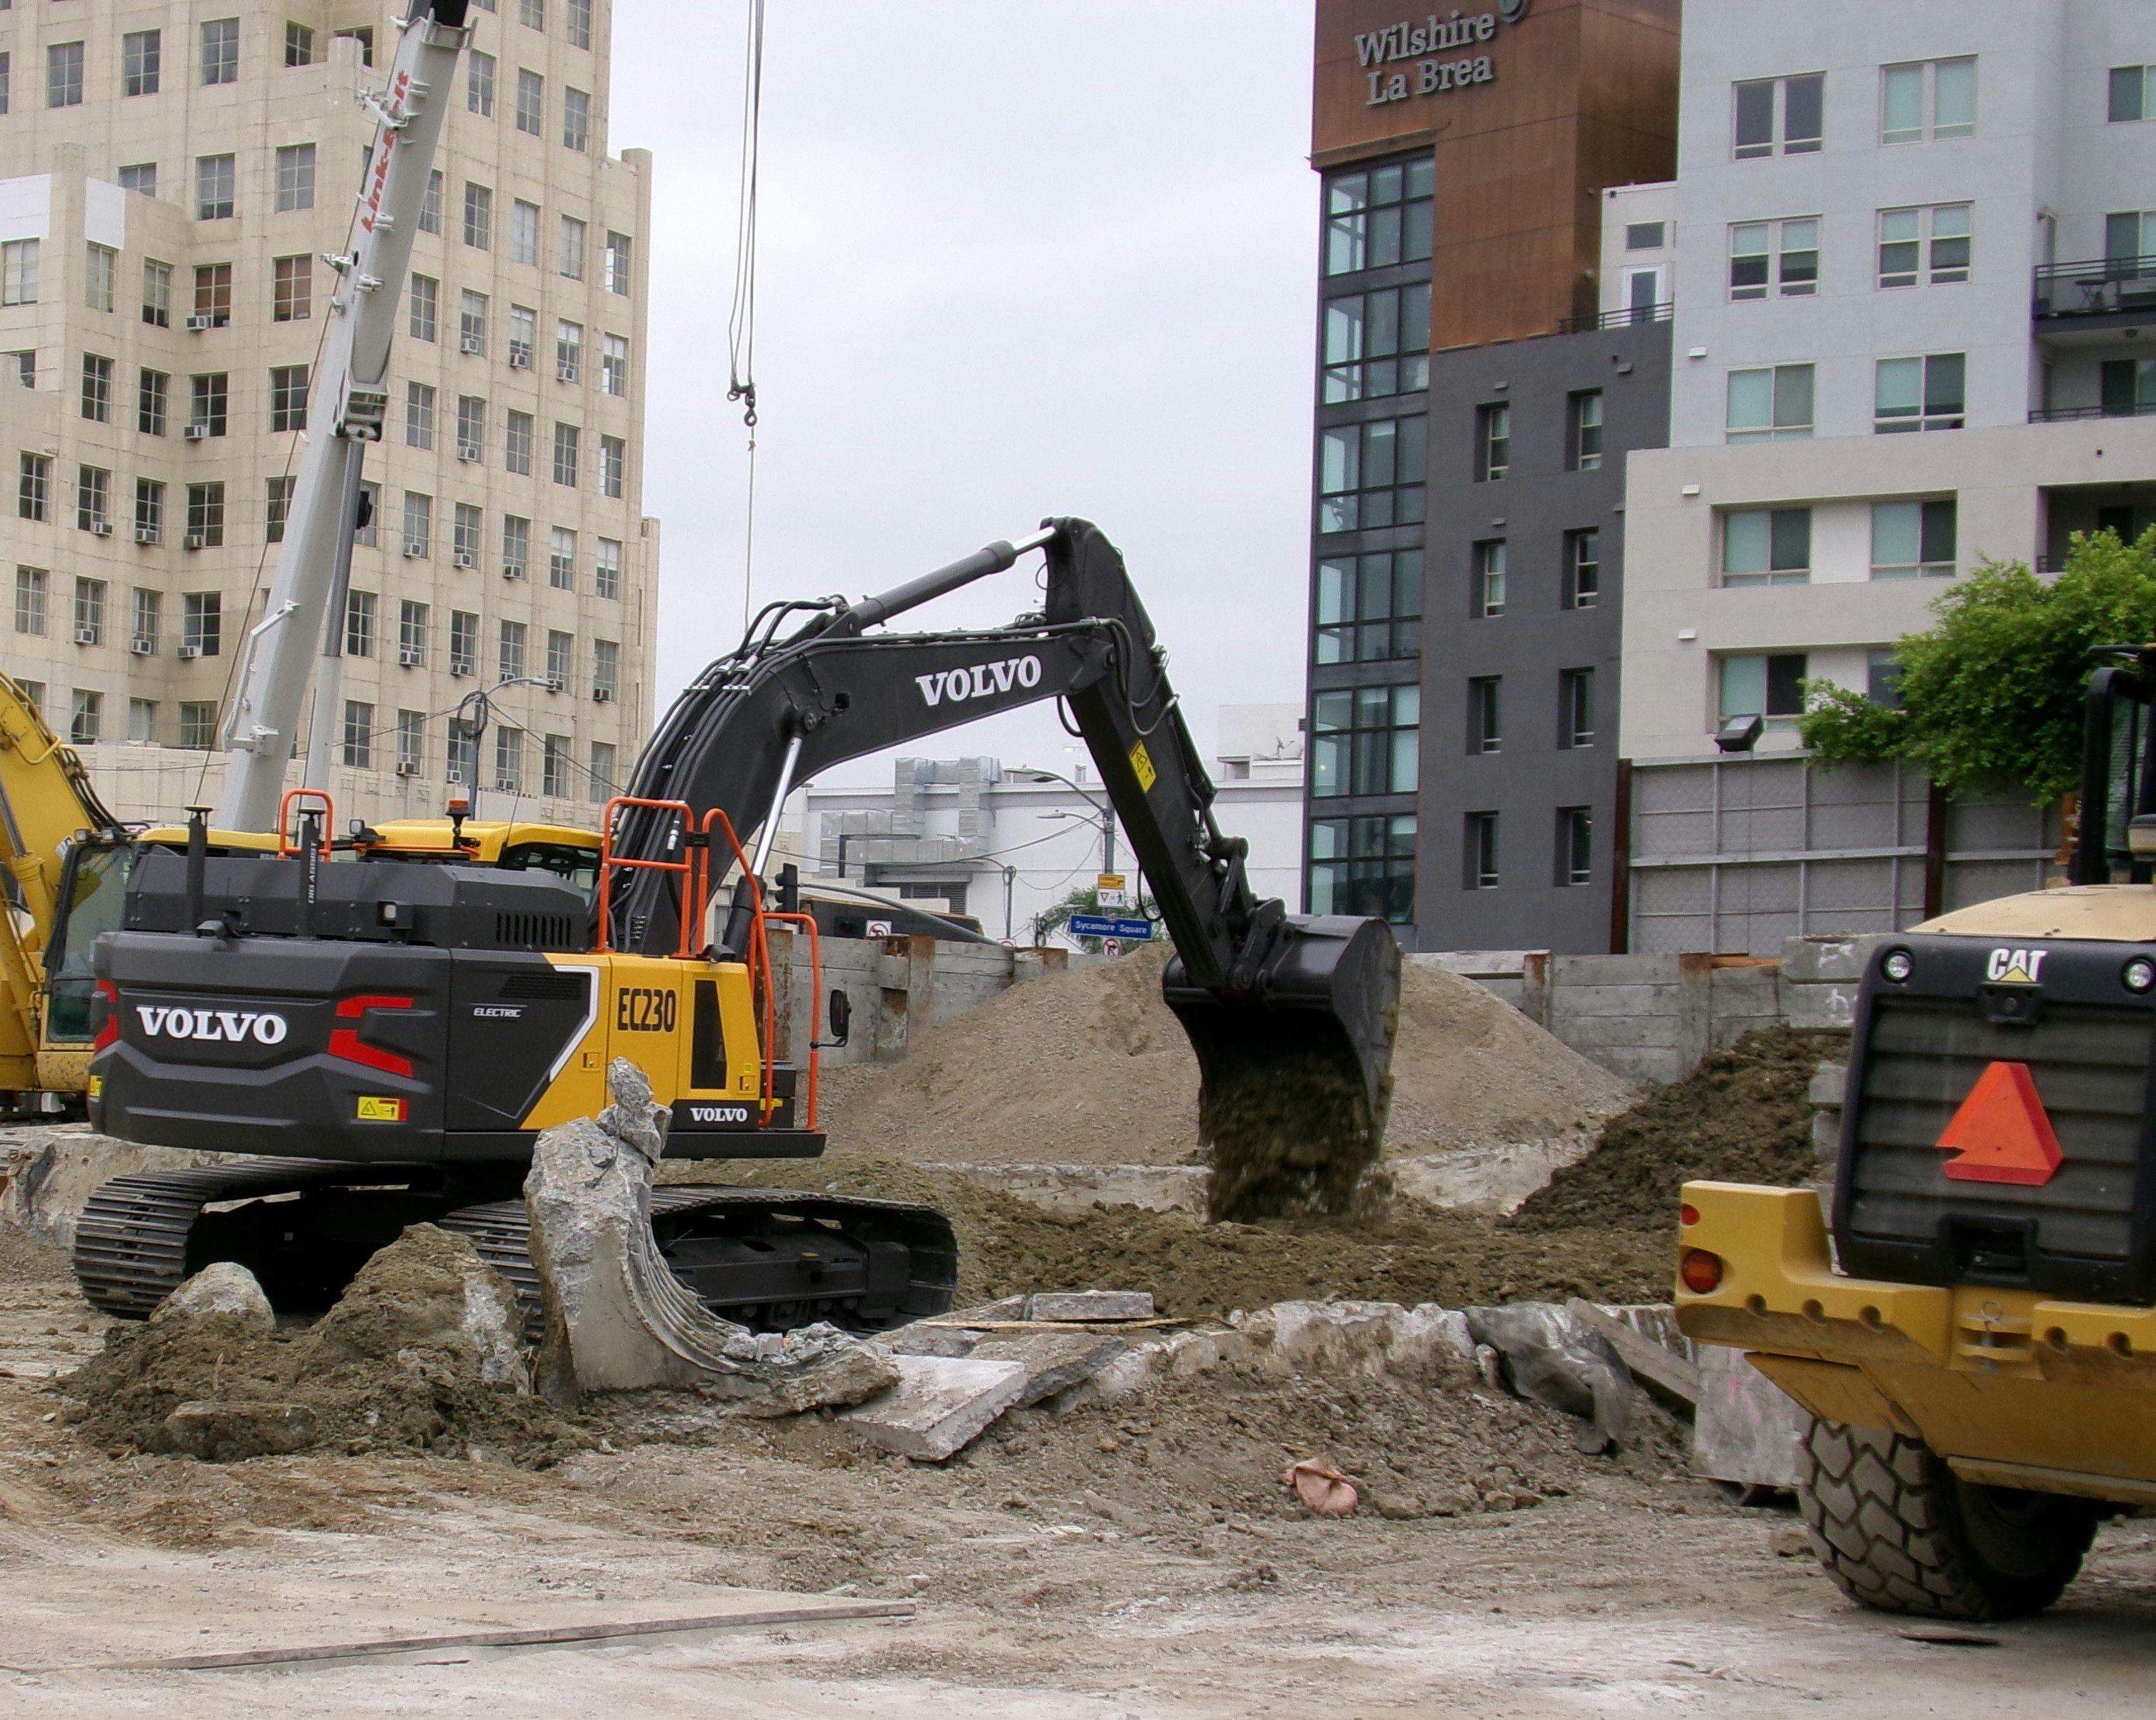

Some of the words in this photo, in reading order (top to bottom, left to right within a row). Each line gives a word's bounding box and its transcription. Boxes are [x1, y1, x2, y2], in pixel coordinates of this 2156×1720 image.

[1354, 9, 1497, 68] Wilshire
[1366, 70, 1408, 107] La
[1416, 53, 1495, 95] Brea
[915, 655, 1043, 706] VOLVO
[1075, 920, 1116, 932] Sycamore
[1119, 924, 1148, 935] Square
[1987, 947, 2048, 983] CAT
[136, 1006, 288, 1045] VOLVO
[473, 1007, 523, 1018] ELECTRIC
[618, 987, 676, 1033] EC230
[690, 1108, 748, 1123] VOLVO
